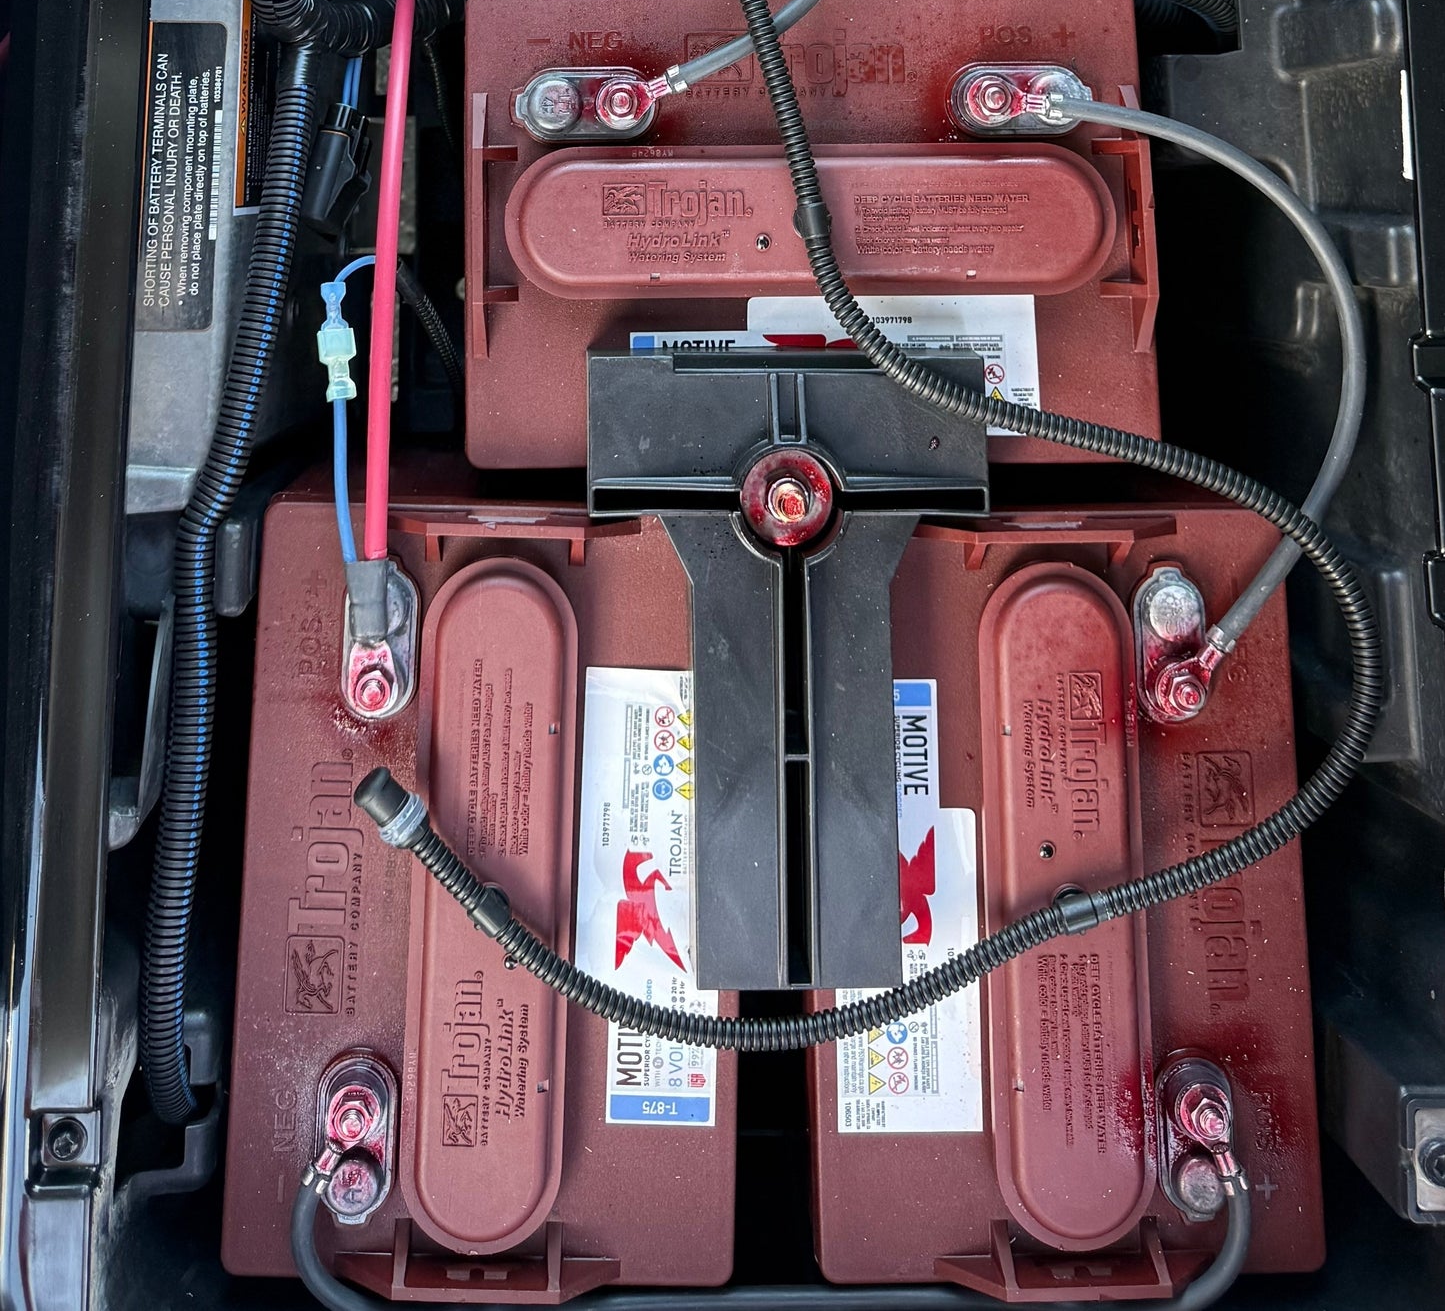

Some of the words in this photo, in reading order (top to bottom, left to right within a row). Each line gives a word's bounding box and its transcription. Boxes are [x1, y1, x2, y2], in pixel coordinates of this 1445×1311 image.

[568, 30, 624, 51] NEG
[980, 25, 1032, 45] POS
[156, 53, 168, 80] CAN
[213, 66, 223, 103] 103384701
[241, 29, 249, 114] WARNING
[170, 71, 182, 116] DEATH.
[186, 76, 199, 104] plate,
[198, 69, 211, 115] batteries.
[152, 82, 167, 155] TERMINALS
[168, 118, 180, 138] OR
[184, 106, 198, 153] mounting
[197, 116, 207, 127] of
[196, 130, 208, 146] top
[197, 149, 206, 162] on
[165, 140, 179, 186] INJURY
[149, 157, 163, 215] BATTERY
[182, 155, 195, 213] component
[194, 165, 207, 201] directly
[854, 195, 878, 204] DEEP
[881, 195, 913, 204] CYCLE
[914, 194, 965, 203] BATTERIES
[968, 194, 991, 203] NEED
[996, 194, 1030, 203] WATER
[148, 217, 159, 236] OF
[162, 189, 176, 259] PERSONAL
[192, 204, 204, 229] plate
[603, 220, 645, 229] BATTERY
[651, 220, 695, 228] COMPANY
[179, 215, 192, 263] removing
[191, 232, 203, 260] place
[628, 251, 680, 263] Watering
[684, 251, 726, 263] System
[144, 239, 158, 307] SHORTING
[158, 262, 172, 307] CAUSE
[176, 265, 187, 296] When
[189, 282, 199, 295] do
[190, 263, 201, 279] not
[872, 316, 912, 324] 103971798
[298, 617, 323, 675] POS
[472, 659, 483, 698] WATER
[1056, 673, 1065, 720] BATTERY
[471, 699, 480, 728] NEED
[1023, 701, 1034, 758] Watering
[469, 730, 479, 788] BATTERIES
[902, 715, 929, 796] MOTIVE
[1058, 725, 1067, 775] COMPANY
[1025, 761, 1036, 808] System
[468, 790, 477, 825] CYCLE
[602, 802, 611, 847] 103971798
[467, 827, 477, 856] DEEP
[350, 852, 363, 931] COMPANY
[346, 941, 359, 1016] BATTERY
[1038, 956, 1048, 984] White
[1090, 955, 1099, 983] DEEP
[1039, 985, 1049, 1009] color
[1091, 985, 1101, 1023] CYCLE
[516, 1004, 529, 1053] System
[1040, 1019, 1050, 1053] battery
[483, 1038, 491, 1090] COMPANY
[1042, 1055, 1050, 1084] needs
[1093, 1024, 1104, 1082] BATTERIES
[515, 1058, 528, 1118] Watering
[669, 1078, 683, 1087] 8
[691, 1074, 706, 1087] USA
[642, 1100, 678, 1115] T-875
[1042, 1086, 1052, 1112] water
[1095, 1084, 1105, 1115] NEED
[273, 1089, 297, 1152] NEG
[480, 1096, 490, 1146] BATTERY
[1097, 1117, 1106, 1155] WATER
